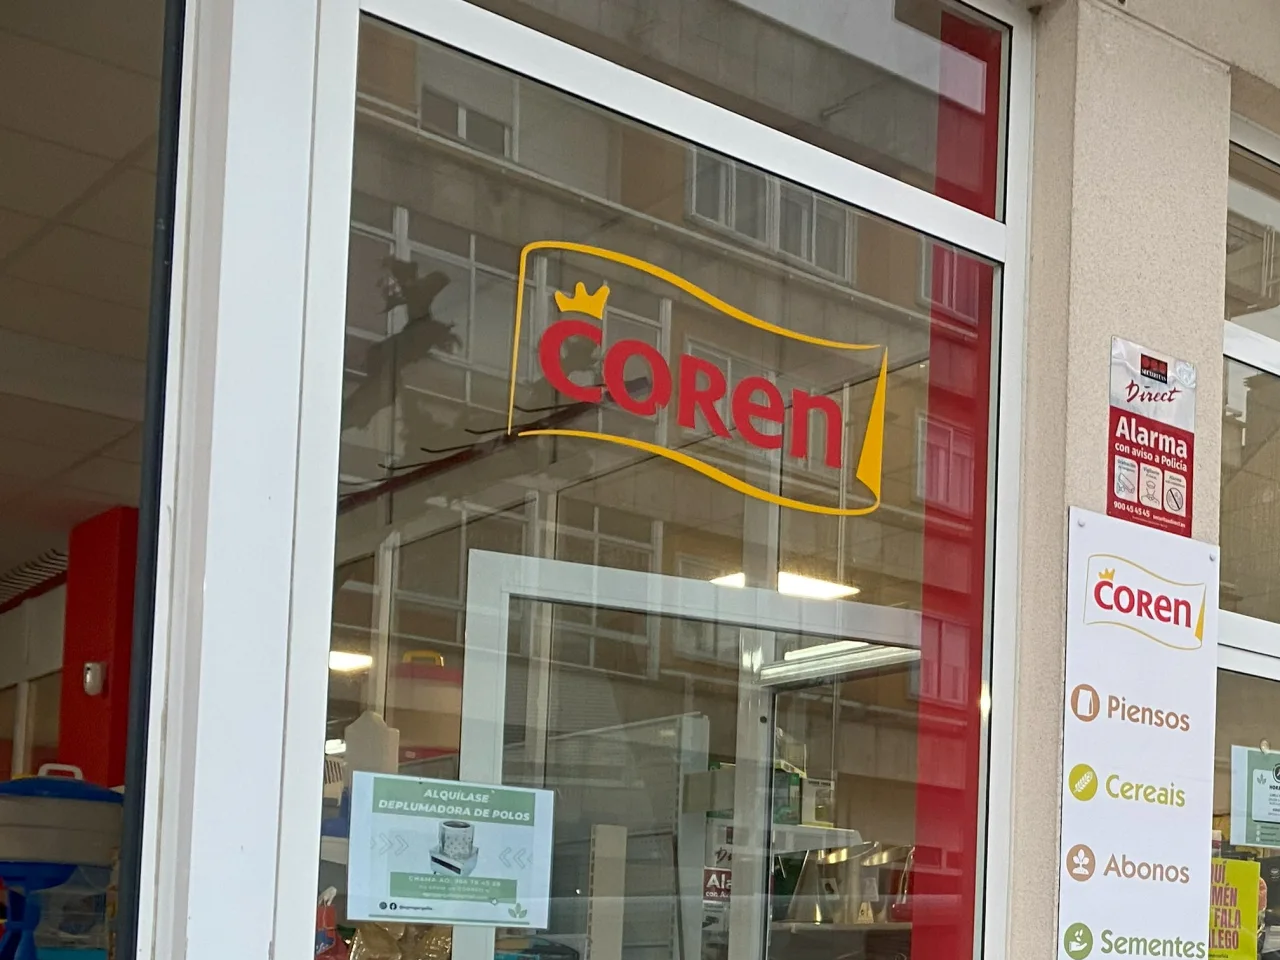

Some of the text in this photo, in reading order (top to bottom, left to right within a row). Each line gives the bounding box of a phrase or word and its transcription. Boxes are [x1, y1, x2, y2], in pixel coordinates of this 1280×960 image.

[1125, 380, 1182, 403] Direct
[1115, 415, 1188, 460] Alarma
[1115, 442, 1188, 473] con aviso a Policía
[1113, 501, 1126, 511] 900
[1107, 694, 1191, 732] Piensos
[424, 788, 490, 803] ALQUÍLASE
[1105, 774, 1186, 808] Cereais
[378, 799, 530, 822] DEPLUMADORA DE POLOS
[1103, 853, 1190, 884] Abonos
[1214, 908, 1242, 929] FALA
[1100, 929, 1207, 960] Sementes
